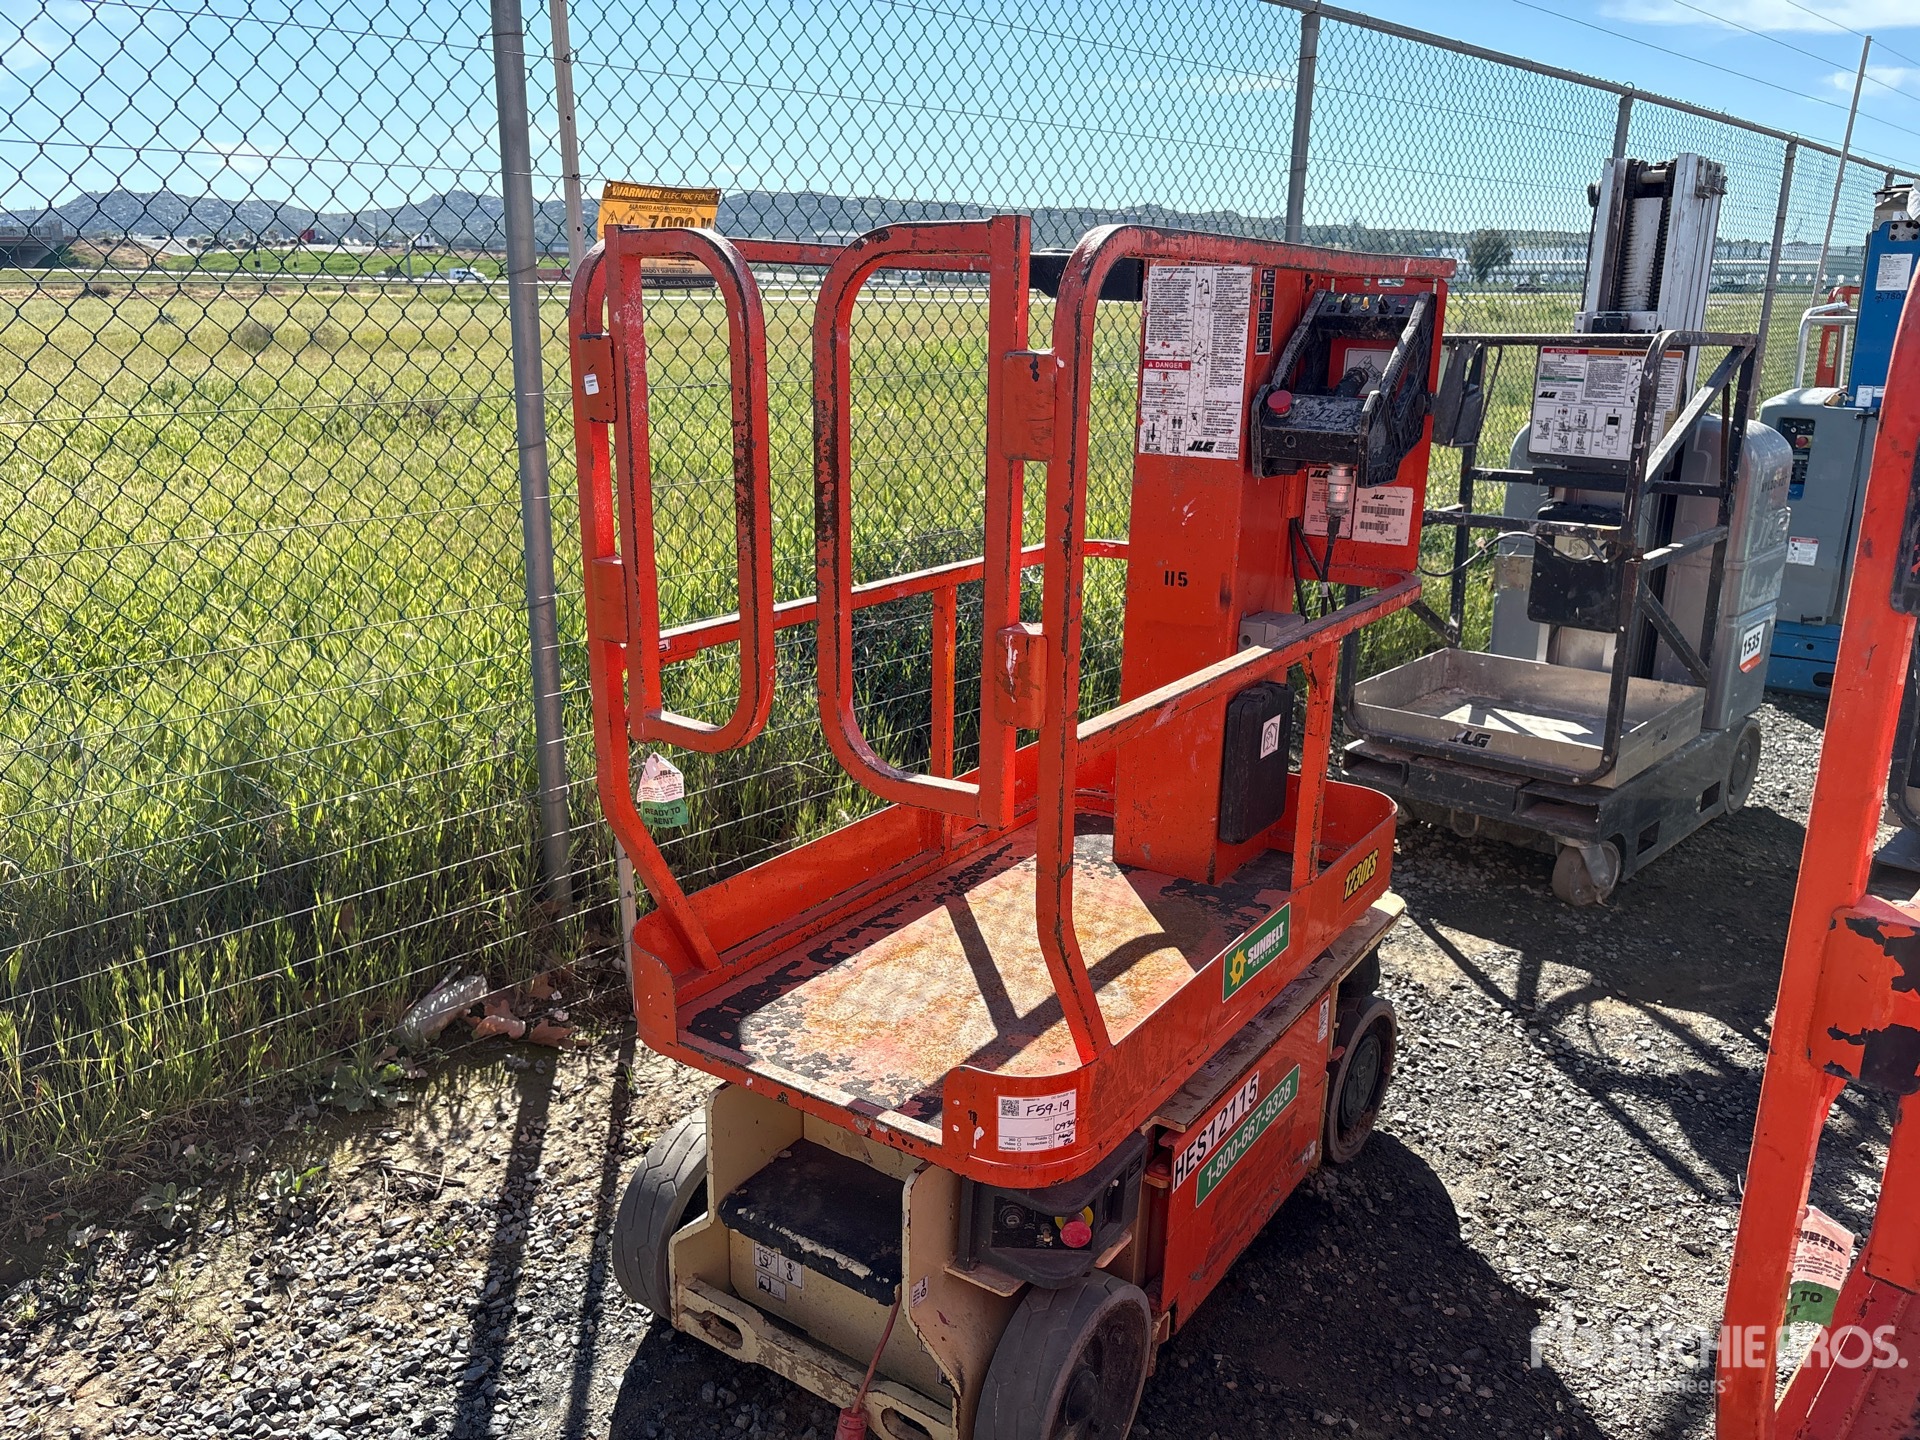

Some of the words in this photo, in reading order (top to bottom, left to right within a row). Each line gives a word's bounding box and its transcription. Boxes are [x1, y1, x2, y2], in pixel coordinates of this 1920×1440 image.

[612, 186, 662, 199] WARNING!
[663, 192, 693, 200] ELECTRIC
[694, 193, 715, 201] FENCE
[664, 205, 693, 213] MONITORED
[1539, 391, 1557, 399] JLG
[1187, 440, 1217, 453] JLG
[1164, 570, 1188, 588] 115
[1743, 631, 1761, 657] 1535
[644, 806, 669, 816] READY
[670, 806, 681, 815] TO
[653, 817, 674, 825] RENT
[1344, 848, 1379, 901] 1230ES
[1247, 921, 1285, 965] SUNBELT
[1251, 942, 1280, 968] RENTALS
[1026, 1099, 1070, 1117] F59-19
[1174, 1073, 1258, 1190] HES12115
[1206, 1079, 1292, 1188] 1-800-667-9328
[1799, 1240, 1834, 1252] TALS
[1800, 1230, 1847, 1256] NBELT
[1800, 1291, 1823, 1303] TO
